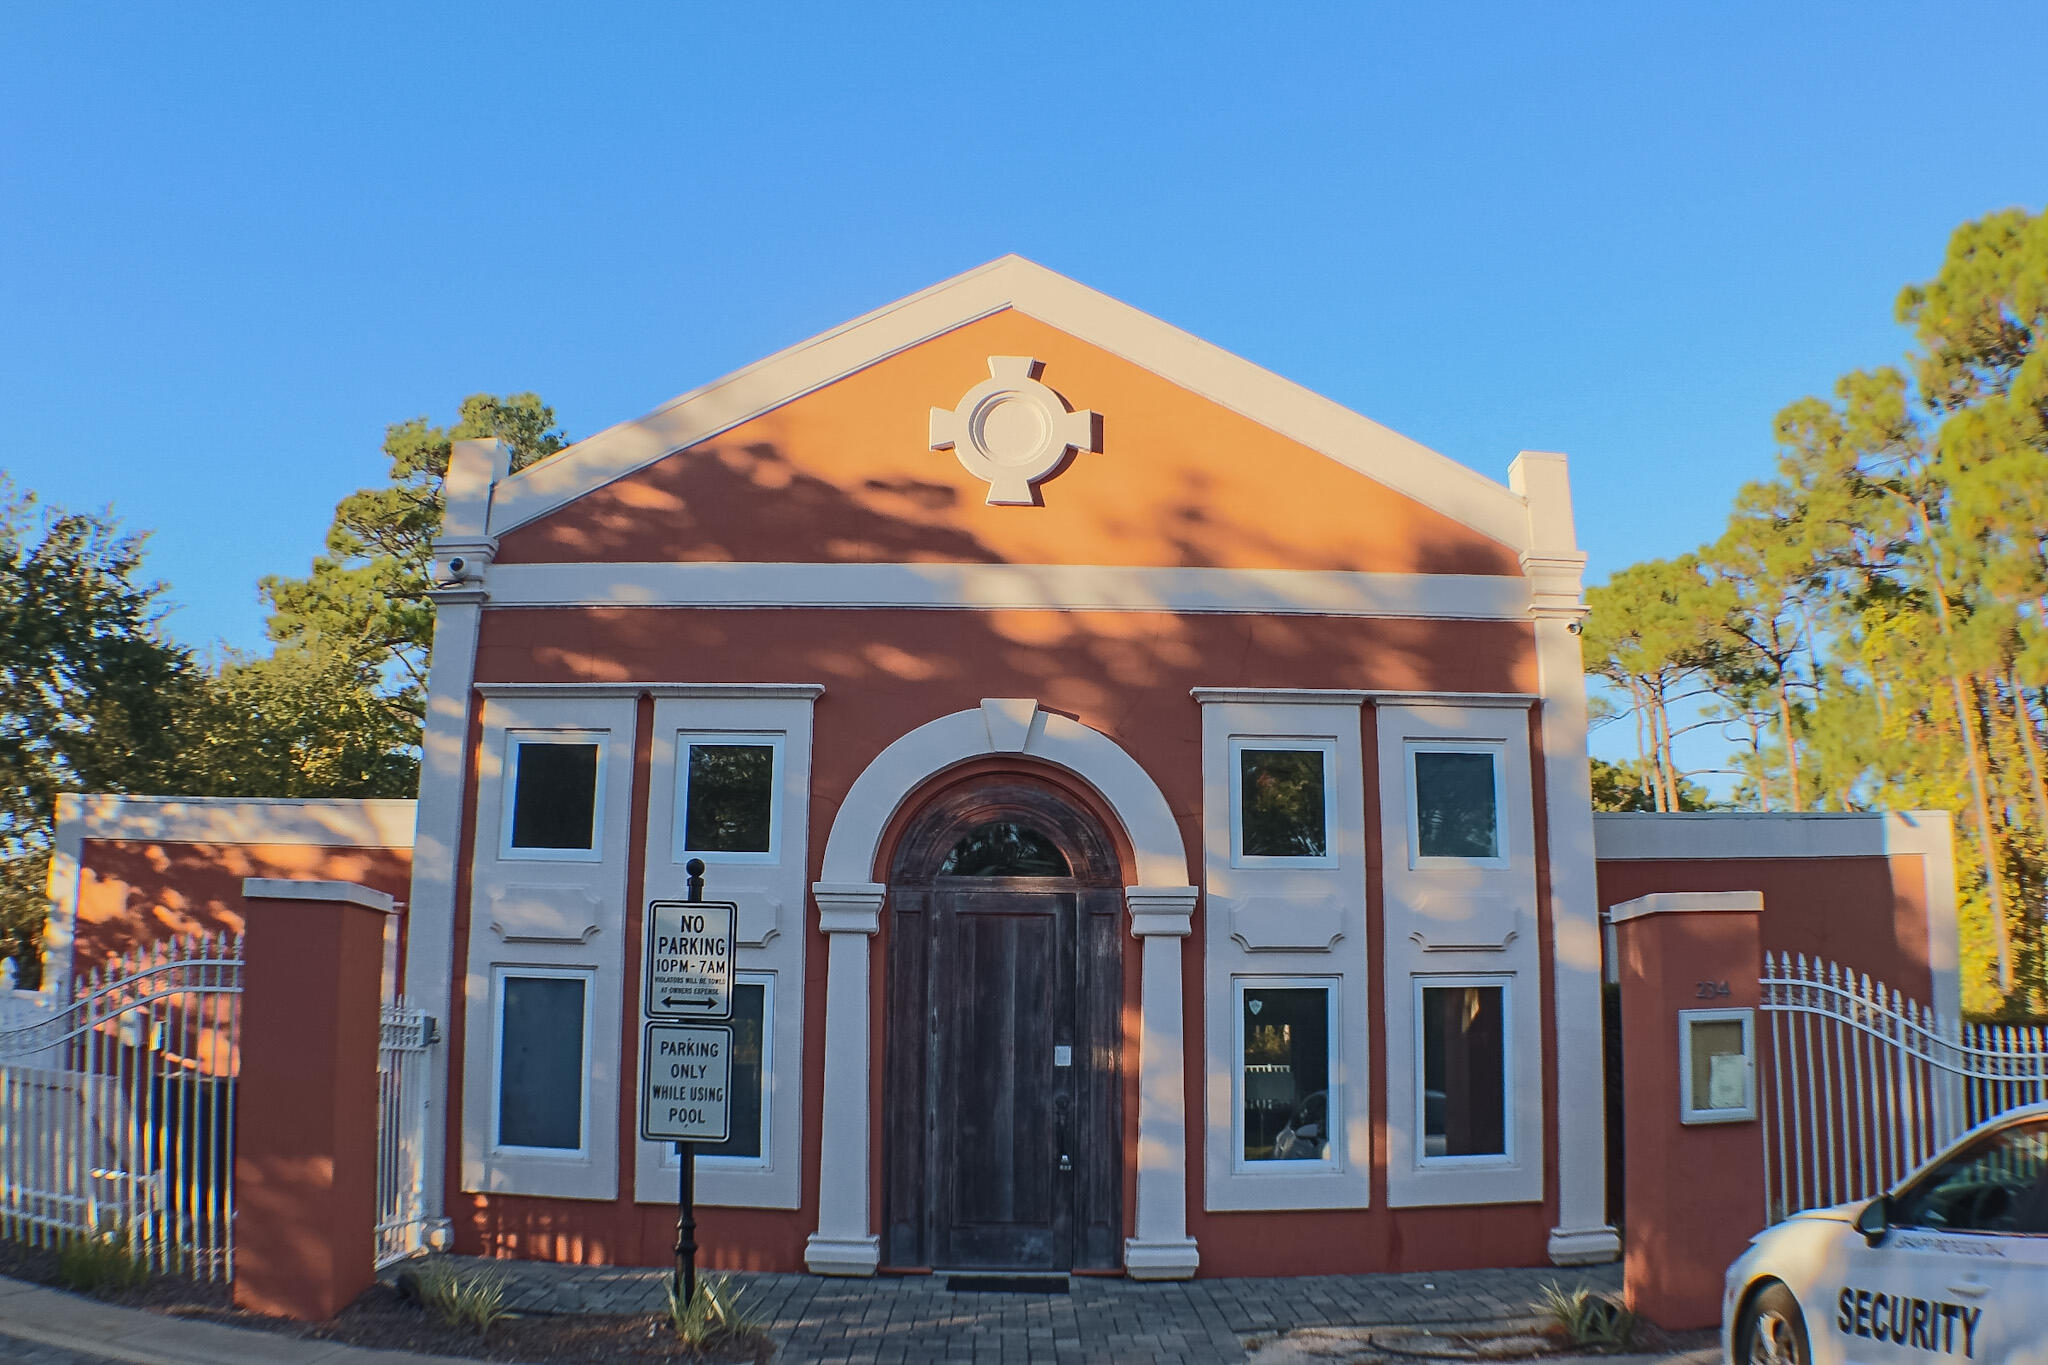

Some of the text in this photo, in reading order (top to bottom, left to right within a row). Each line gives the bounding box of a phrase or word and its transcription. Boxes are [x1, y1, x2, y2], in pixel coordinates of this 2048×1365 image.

[681, 915, 704, 933] NO
[658, 937, 725, 956] PARKING
[660, 1041, 719, 1057] PARKING
[670, 1063, 707, 1079] ONLY
[652, 1085, 723, 1102] WHILE USING
[669, 1108, 706, 1124] POOL
[1837, 1286, 1983, 1360] SECURITY
